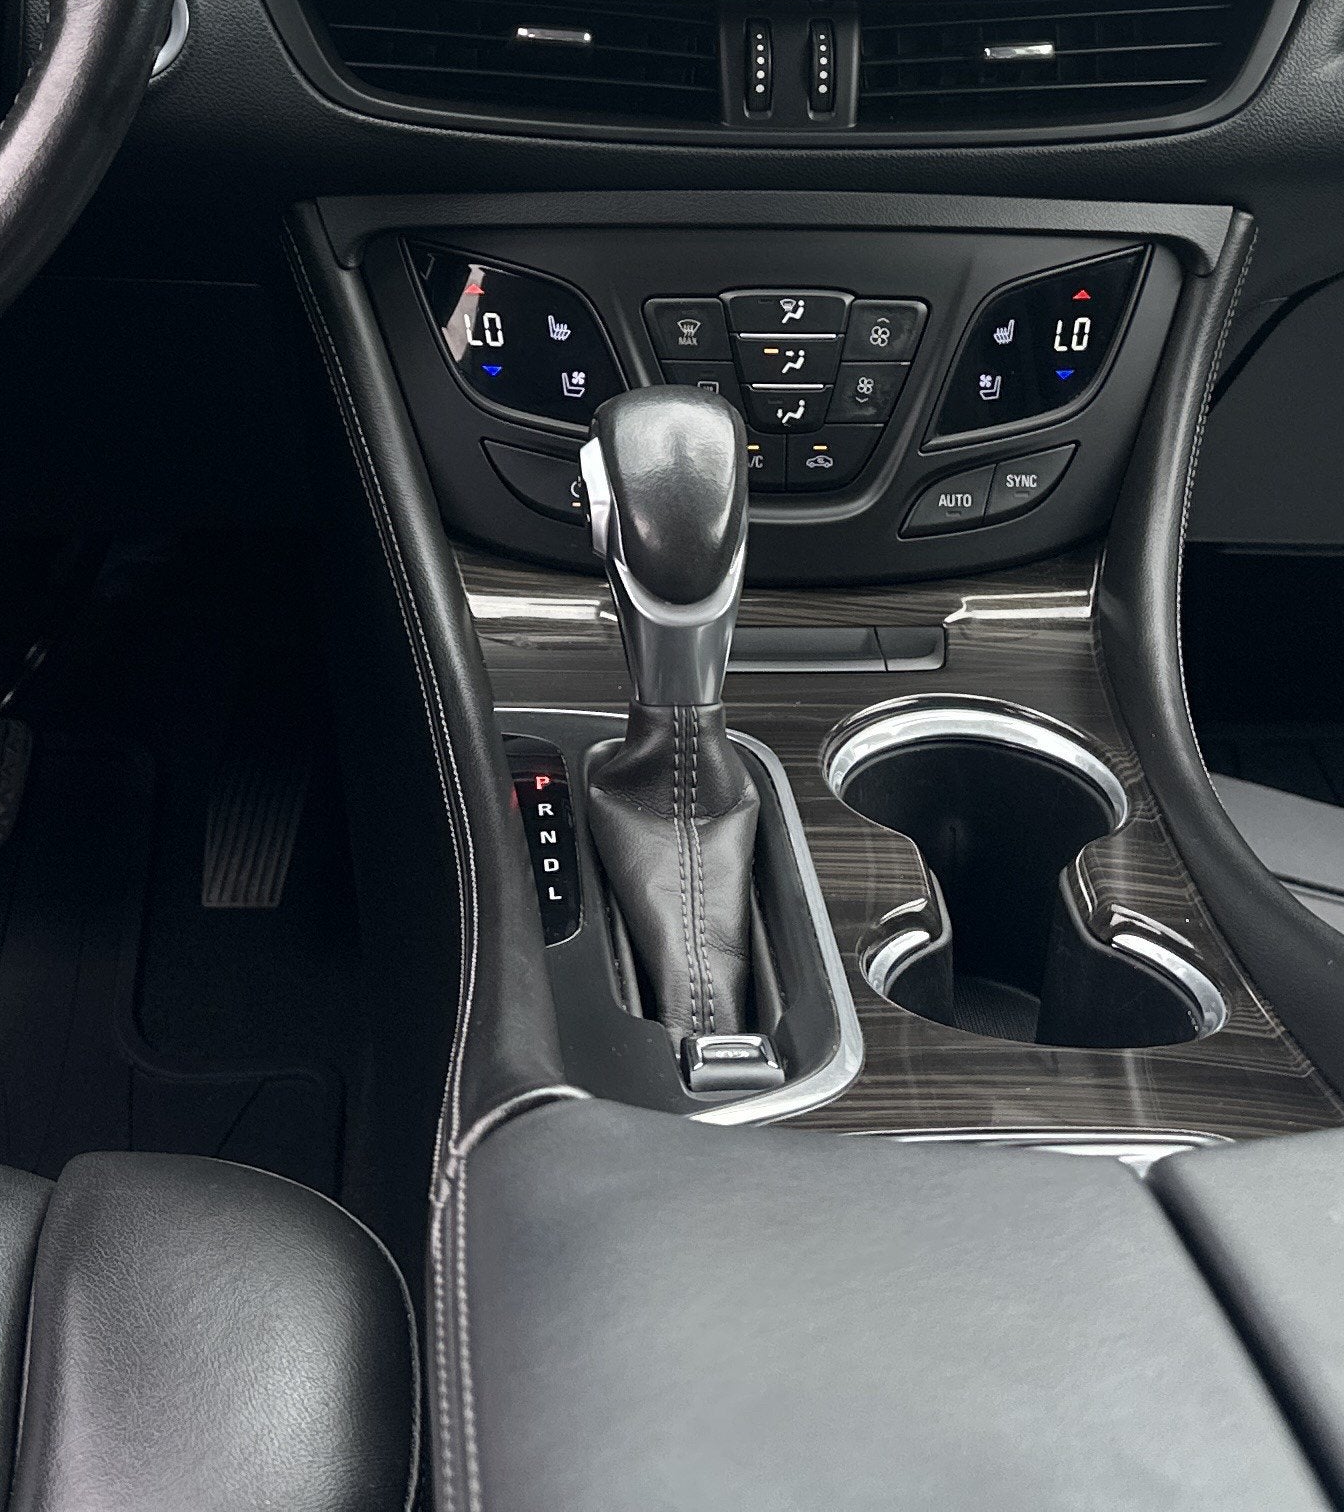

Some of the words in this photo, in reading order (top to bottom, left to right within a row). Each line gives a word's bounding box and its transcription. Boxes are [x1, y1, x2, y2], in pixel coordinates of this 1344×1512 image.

[678, 337, 699, 346] MAX
[1006, 473, 1038, 490] SYNC
[938, 492, 973, 508] AUTO
[535, 775, 551, 790] P
[537, 803, 555, 817] R
[540, 830, 557, 844] N
[543, 858, 560, 872] D
[548, 886, 562, 901] L
